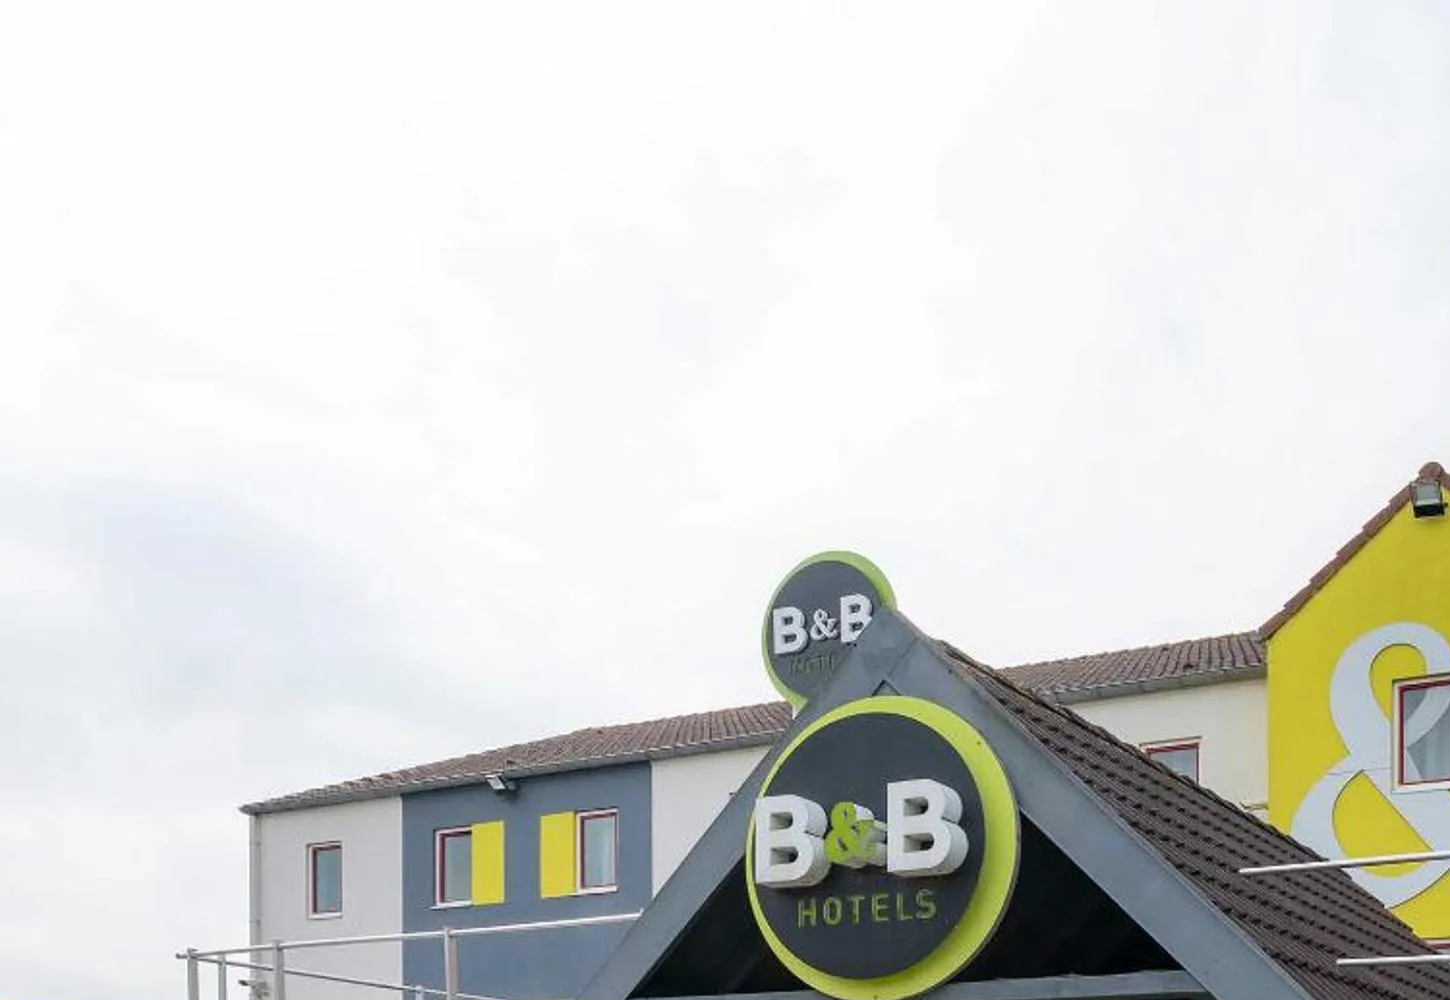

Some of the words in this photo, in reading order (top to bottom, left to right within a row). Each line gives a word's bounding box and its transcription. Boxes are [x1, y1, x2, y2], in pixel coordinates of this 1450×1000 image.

[773, 593, 873, 655] B&B
[755, 778, 969, 889] B&B
[797, 888, 938, 928] HOTELS
